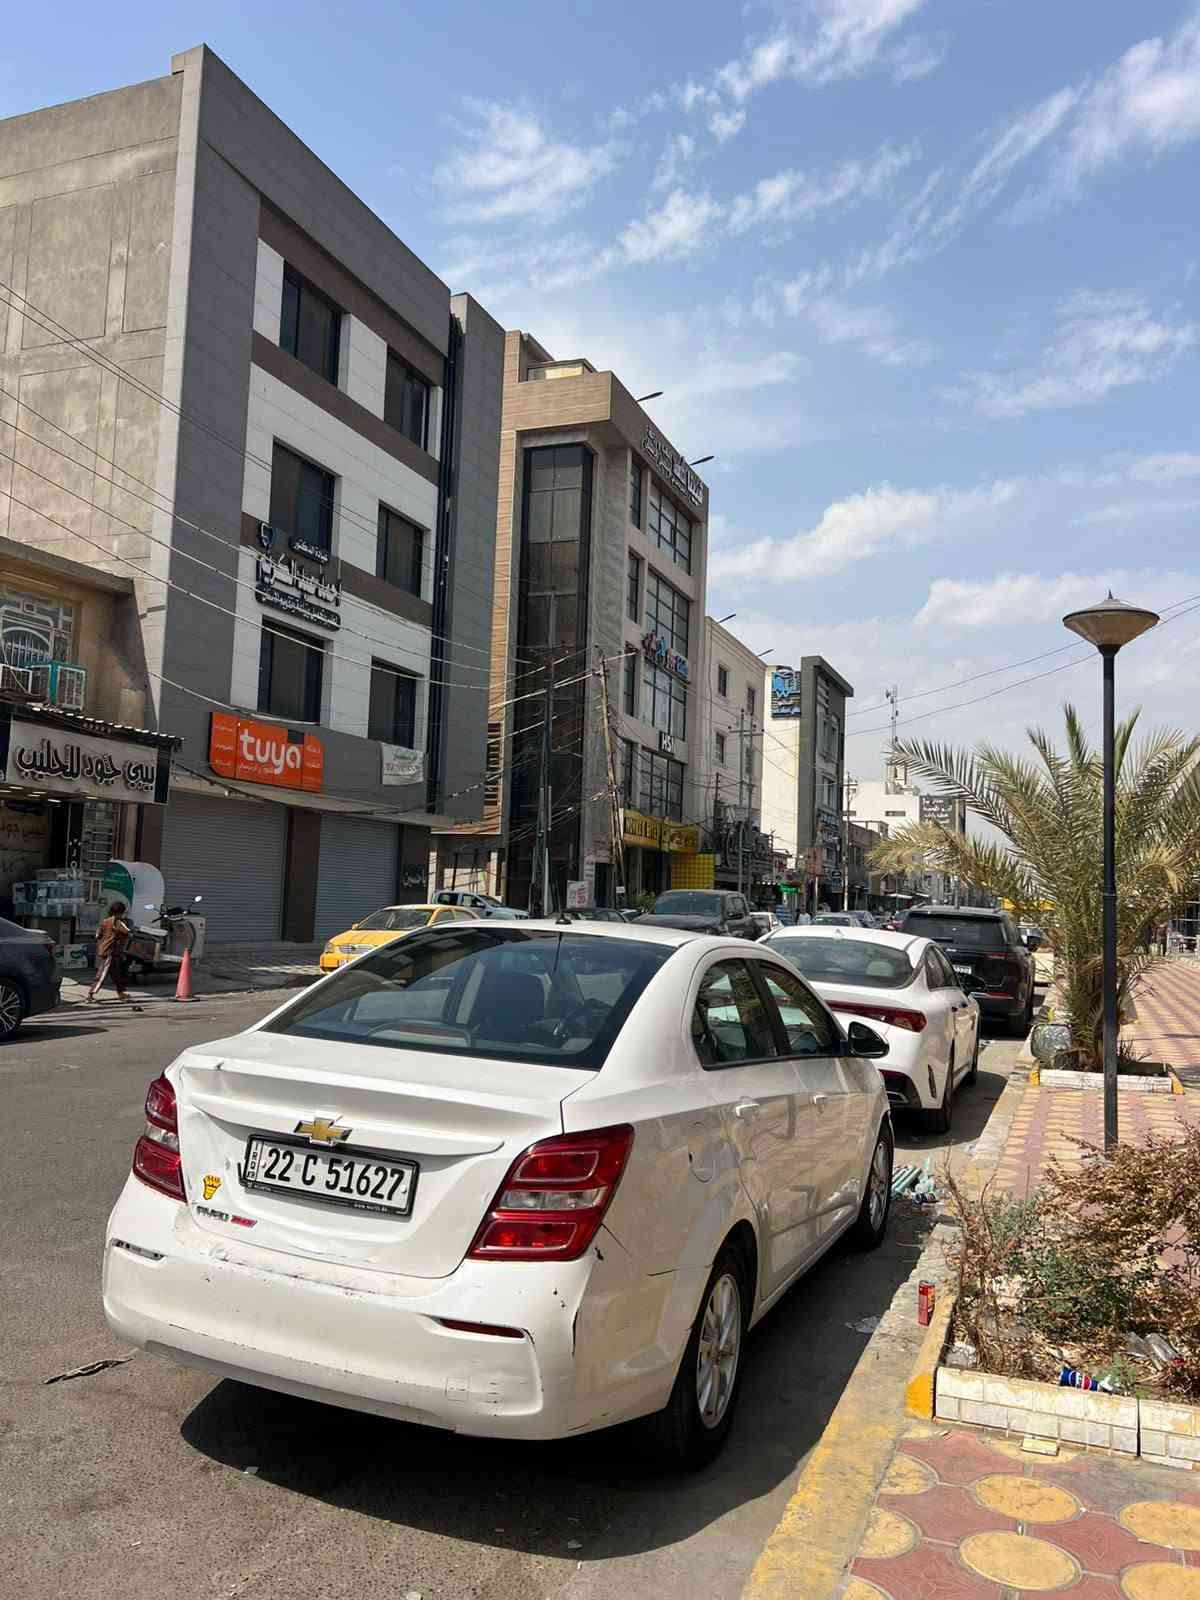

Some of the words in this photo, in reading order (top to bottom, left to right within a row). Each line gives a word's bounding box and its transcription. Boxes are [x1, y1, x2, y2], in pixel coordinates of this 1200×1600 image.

[240, 728, 301, 775] tuya
[264, 1148, 295, 1182] 22
[302, 1154, 318, 1186] C
[325, 1158, 405, 1201] 51627
